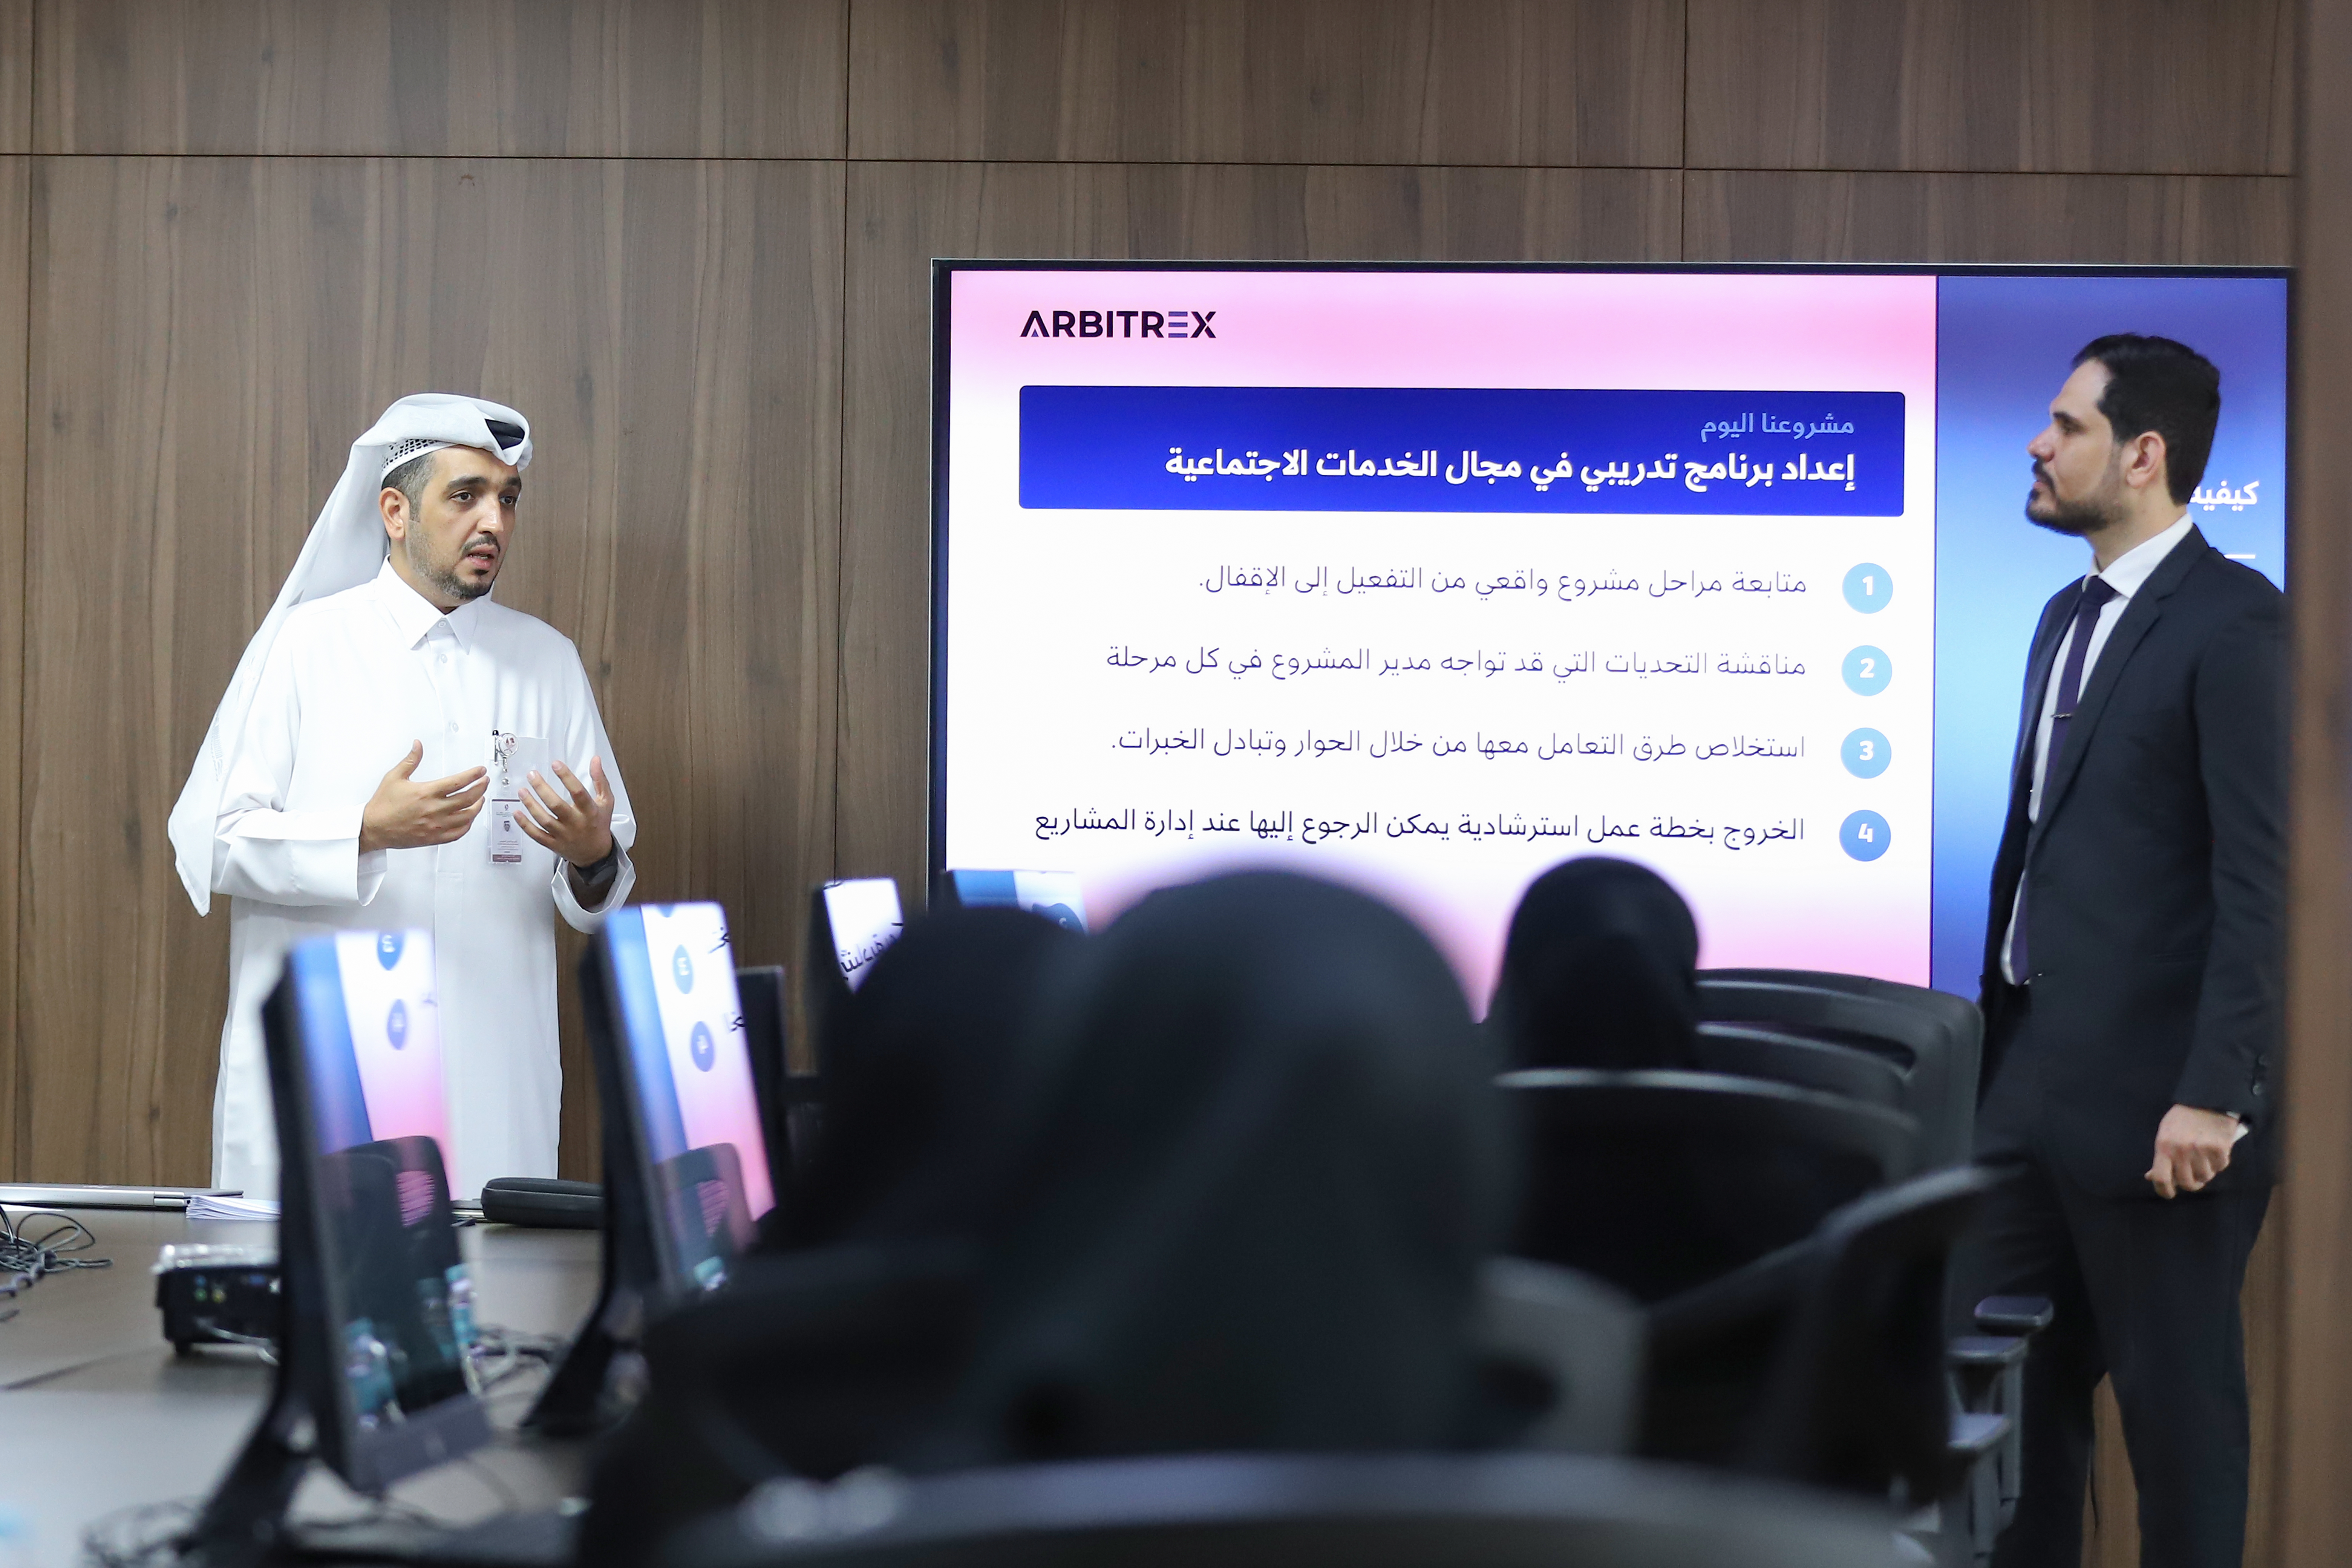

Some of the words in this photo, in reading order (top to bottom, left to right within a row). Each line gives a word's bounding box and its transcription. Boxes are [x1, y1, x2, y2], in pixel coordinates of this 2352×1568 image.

[1020, 310, 1216, 338] ARBITREX
[1701, 413, 1754, 443] اليوم
[1762, 413, 1854, 439] مشروعنا
[1165, 447, 1308, 482] الاجتماعية
[1316, 449, 1437, 476] الخدمات
[1445, 450, 1522, 484] مجال
[1530, 452, 1573, 491] في
[1581, 452, 1678, 492] تدريبي
[1684, 451, 1773, 492] برنامج
[1782, 452, 1856, 491] إعداد
[1199, 565, 1285, 595] الإقفال.
[1295, 566, 1328, 596] إلى
[1337, 566, 1422, 594] التفعيل
[1432, 572, 1465, 593] من
[1475, 568, 1548, 601] واقعي
[1558, 568, 1639, 602] مشروع
[1649, 570, 1722, 598] مراحل
[1732, 571, 1806, 599] متابعة
[1862, 575, 1873, 596] 1
[1107, 645, 1176, 674] مرحلة
[1186, 646, 1220, 674] كل
[1228, 649, 1262, 680] في
[1272, 647, 1369, 680] المشروع
[1378, 655, 1431, 680] مدير
[1440, 649, 1506, 678] تواجه
[1514, 652, 1543, 672] قد
[1553, 651, 1595, 684] التي
[1605, 651, 1707, 679] التحديات
[1717, 652, 1805, 675] مناقشة
[1860, 658, 1875, 678] 2
[1112, 727, 1204, 755] الخبرات.
[1213, 728, 1286, 757] وتبادل
[1294, 729, 1360, 758] الحوار
[1369, 730, 1423, 758] خلال
[1432, 735, 1467, 757] من
[1477, 731, 1528, 760] معها
[1537, 732, 1623, 761] التعامل
[1633, 734, 1686, 762] طرق
[1695, 735, 1804, 760] استخلاص
[1859, 740, 1874, 761] 3
[1035, 807, 1135, 841] المشاريع
[1144, 809, 1194, 840] إدارة
[1202, 812, 1240, 831] عند
[1250, 810, 1293, 841] إليها
[1302, 812, 1377, 845] الرجوع
[1386, 813, 1450, 841] يمكن
[1458, 813, 1578, 842] استرشادية
[1587, 815, 1640, 844] عمل
[1649, 816, 1714, 845] بخطة
[1723, 818, 1804, 851] الخروج
[1858, 823, 1874, 843] 4
